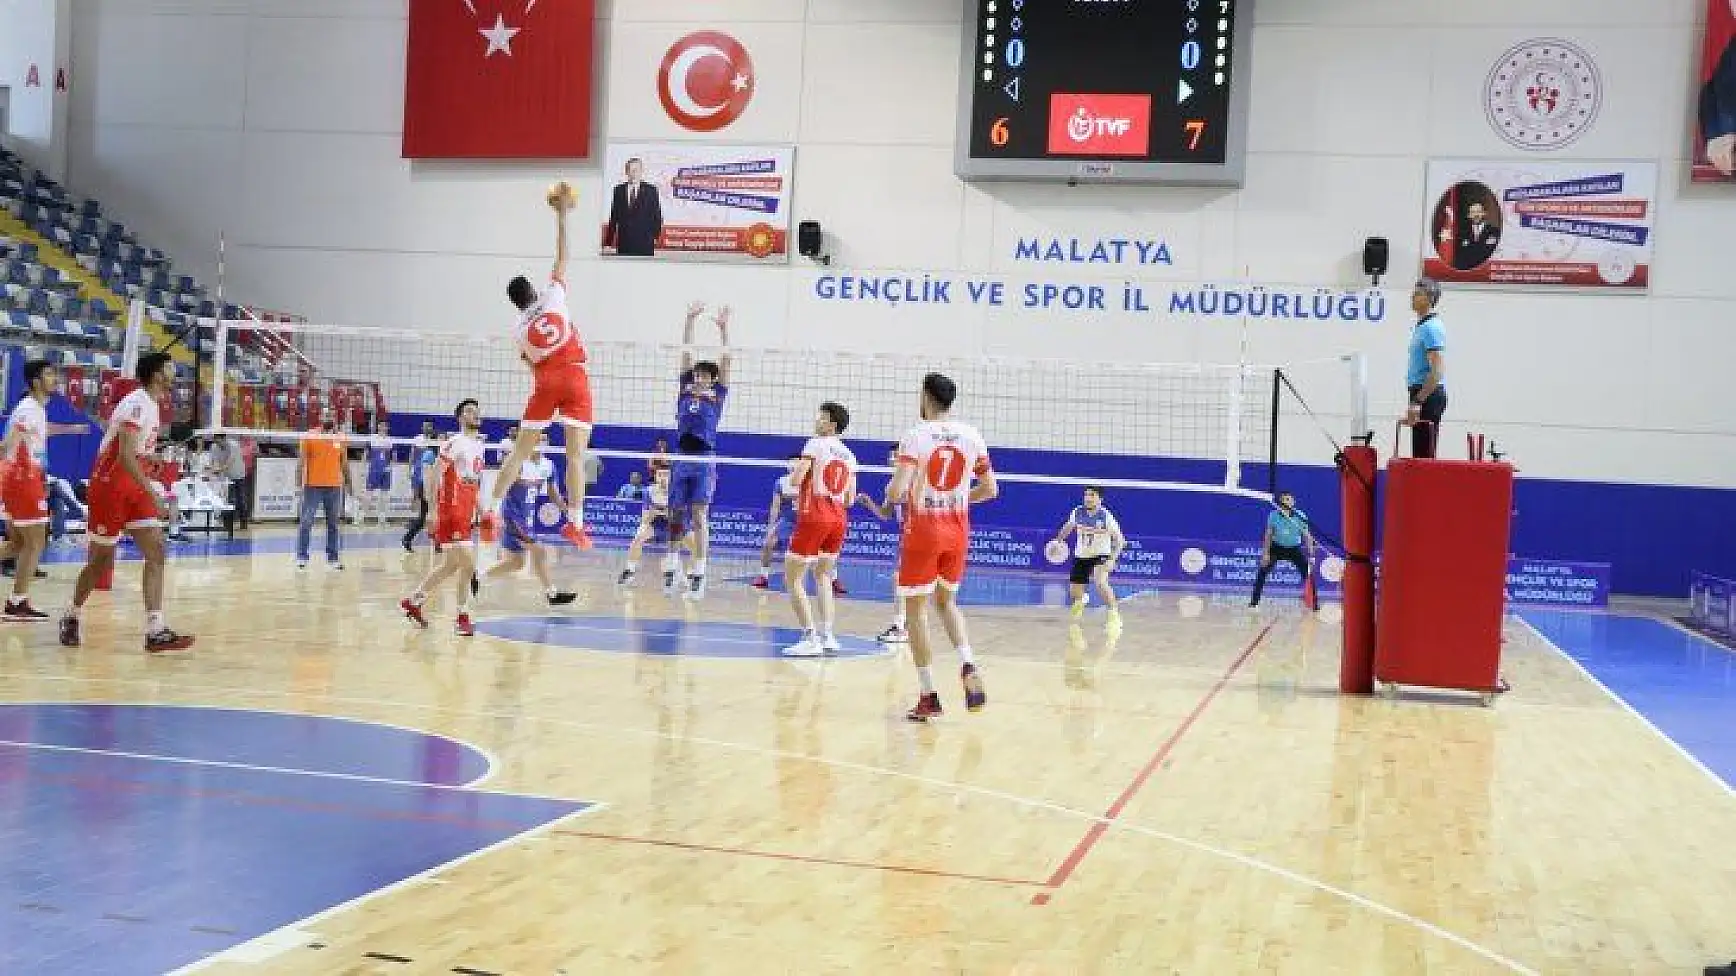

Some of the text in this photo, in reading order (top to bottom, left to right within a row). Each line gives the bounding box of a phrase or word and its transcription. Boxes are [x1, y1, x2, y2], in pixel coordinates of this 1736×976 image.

[1006, 39, 1024, 66] 0
[1182, 42, 1199, 69] 0
[25, 63, 40, 87] A
[991, 118, 1008, 145] 6
[1095, 118, 1132, 136] TVF
[1186, 121, 1203, 149] 7
[1014, 237, 1172, 266] MALATYA
[815, 274, 1386, 321] GENÇLİK VE SPOR İL MÜDÜRLÜĞÜ
[534, 317, 559, 345] 5
[937, 450, 954, 487] 7
